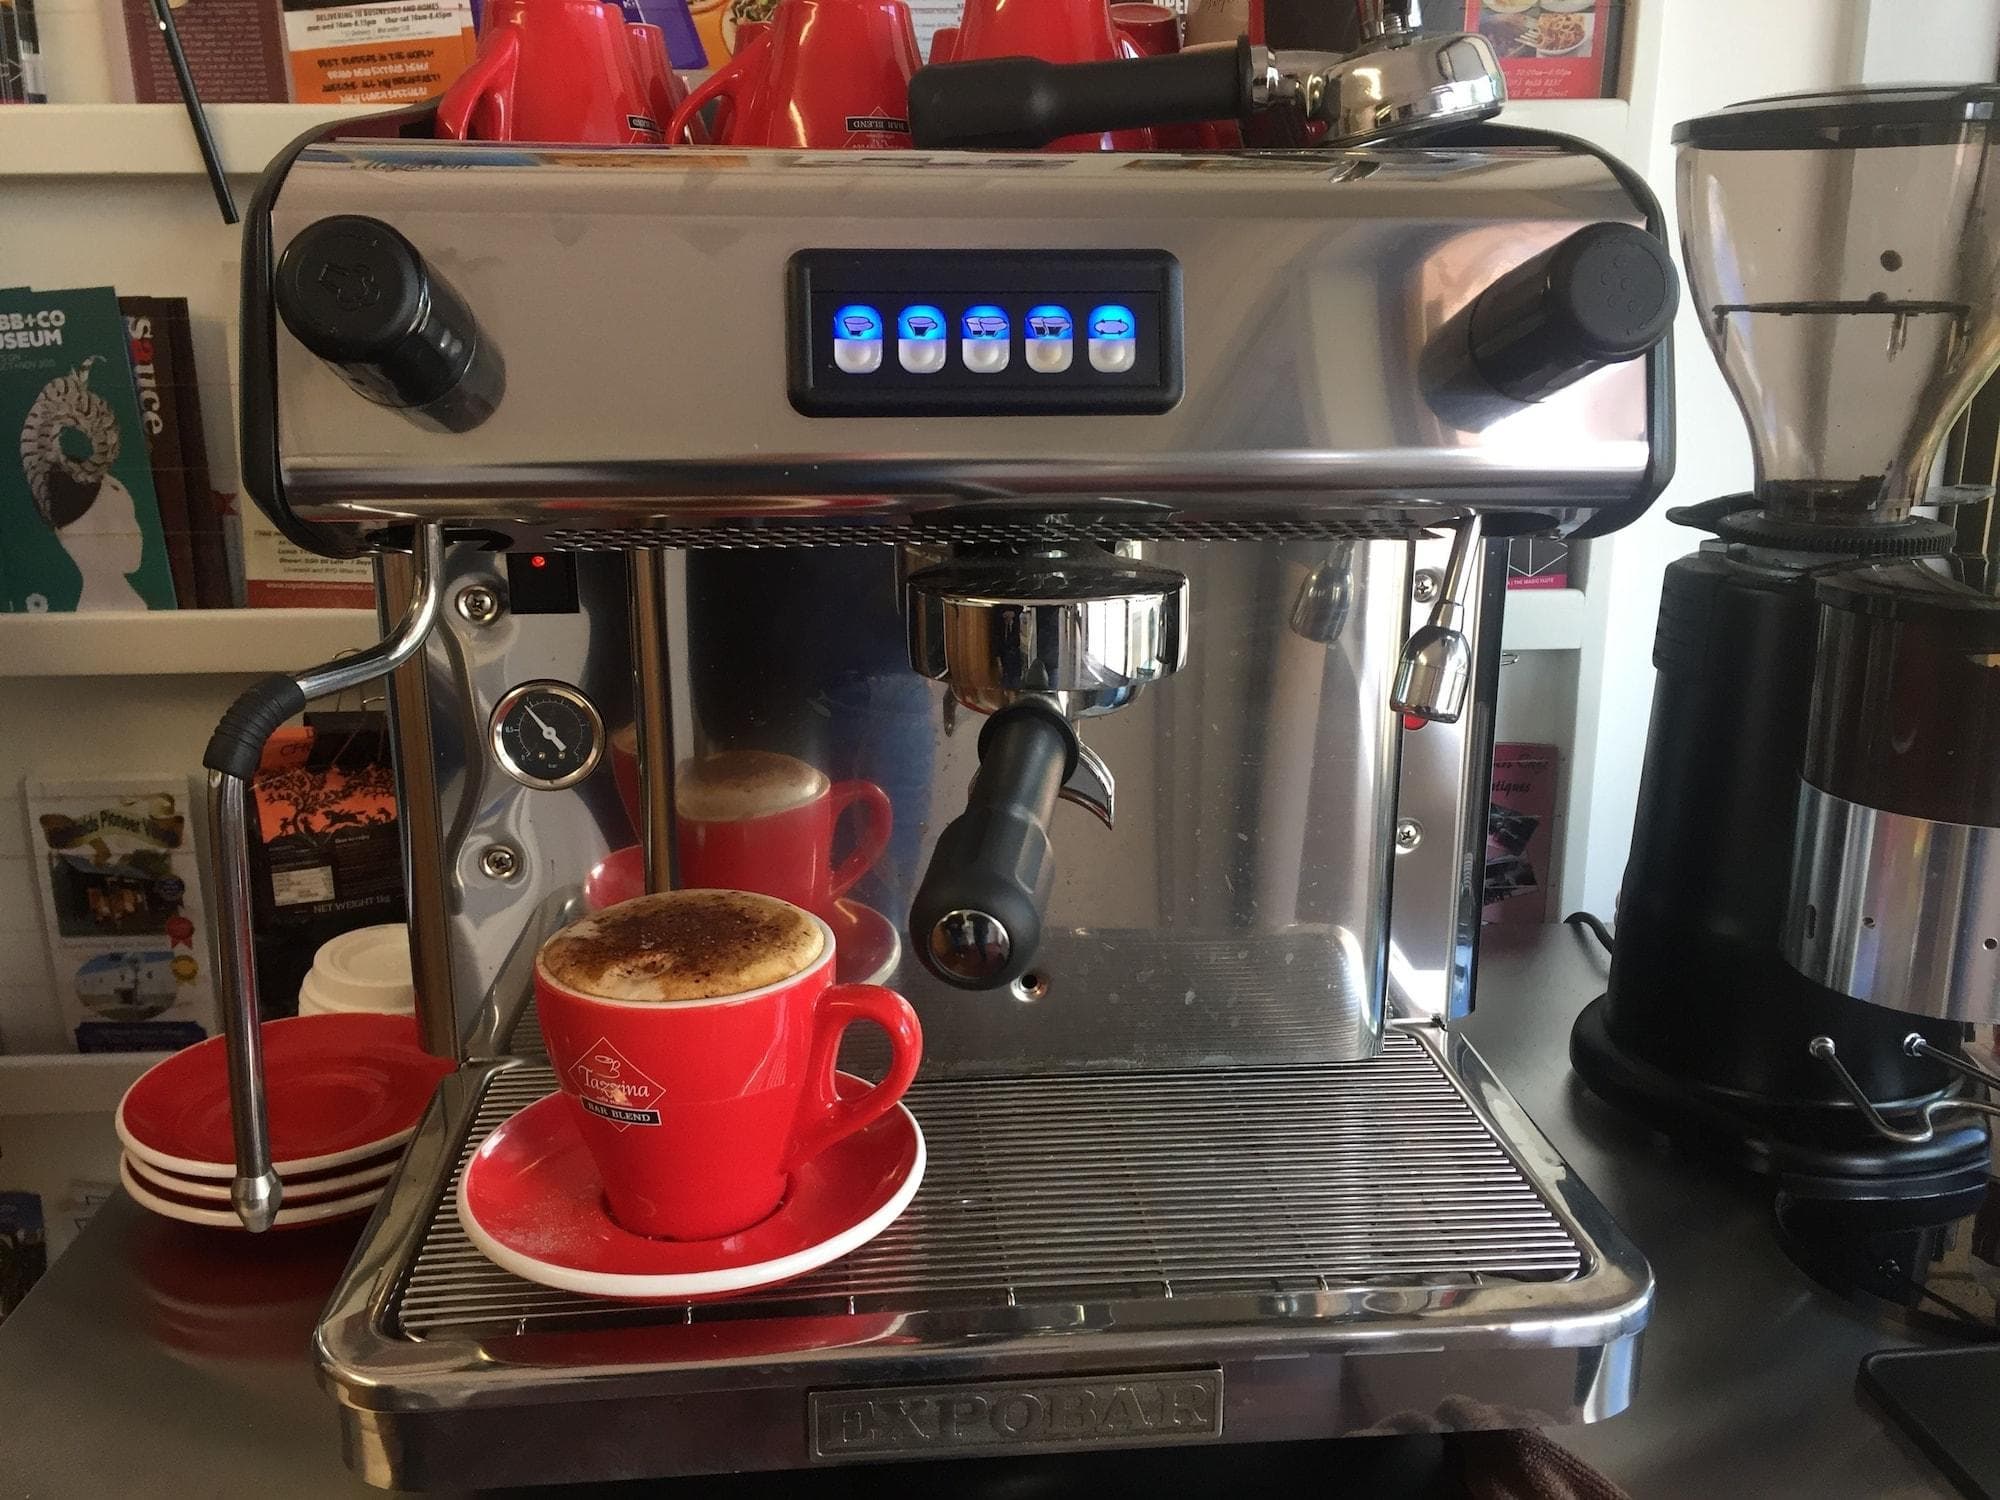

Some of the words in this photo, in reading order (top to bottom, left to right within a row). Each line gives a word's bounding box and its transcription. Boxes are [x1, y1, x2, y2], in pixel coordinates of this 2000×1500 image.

[587, 1103, 609, 1116] BAR
[611, 1108, 651, 1122] BLEND
[827, 1384, 1209, 1446] EXPOBAR
